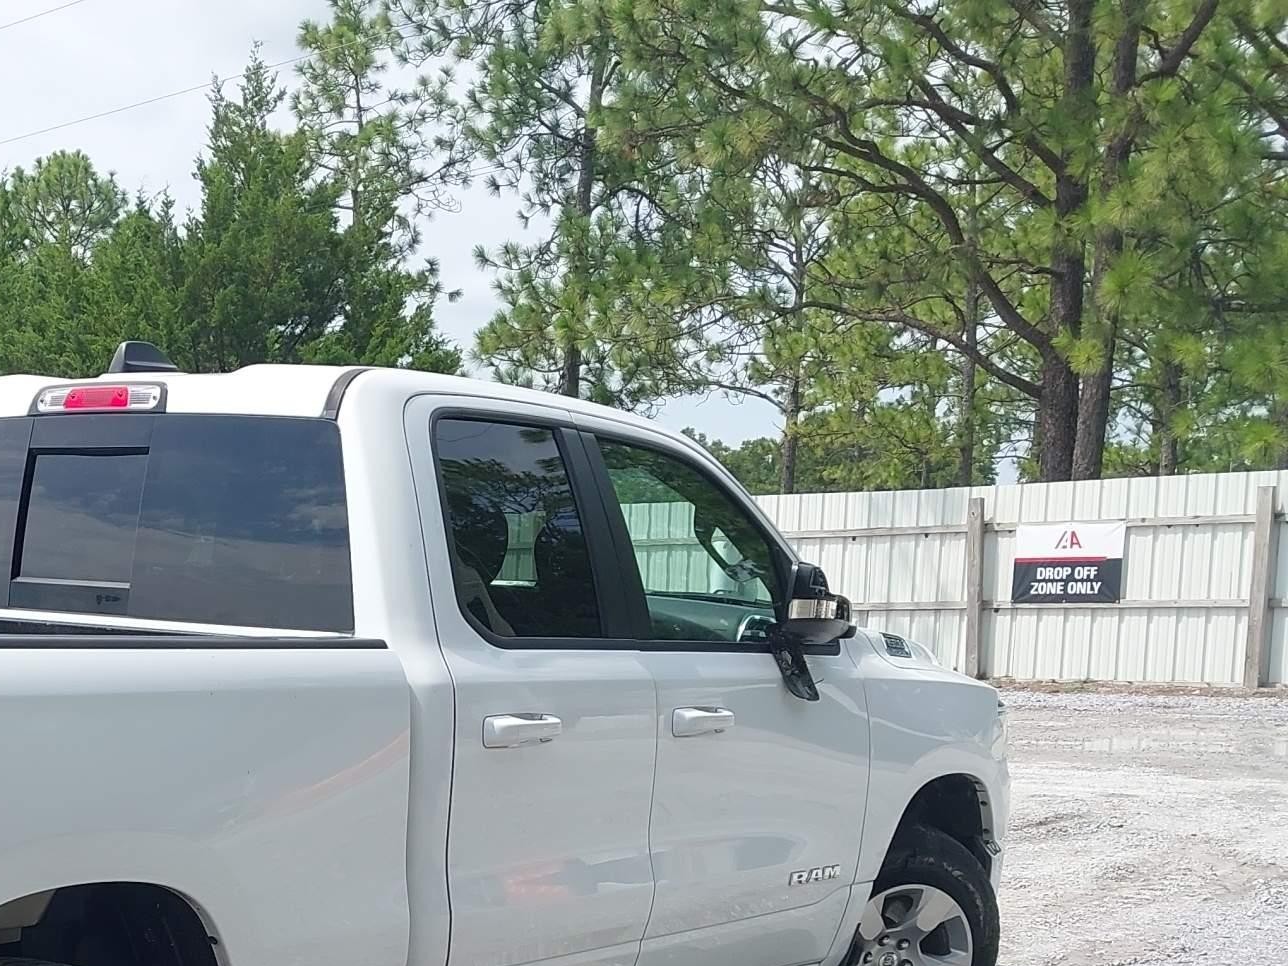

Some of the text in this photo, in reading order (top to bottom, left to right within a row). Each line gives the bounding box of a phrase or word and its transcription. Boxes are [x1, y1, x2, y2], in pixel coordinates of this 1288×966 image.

[1036, 567, 1099, 580] DROP OFF
[1030, 582, 1102, 595] ZONE ONLY
[788, 864, 841, 887] RAM
